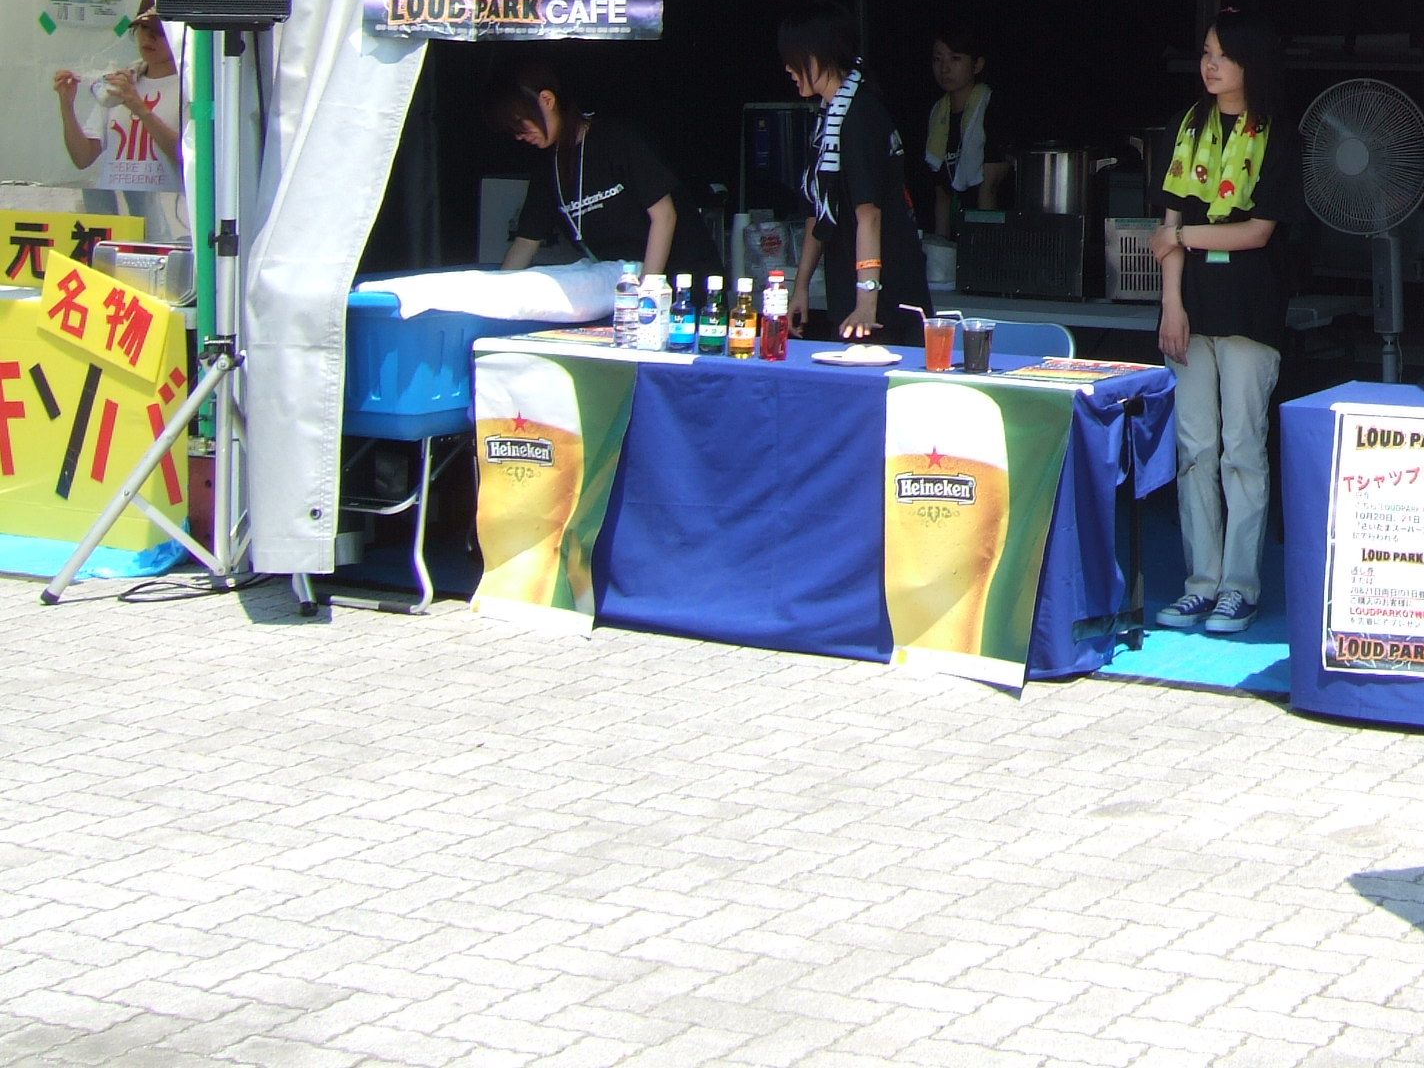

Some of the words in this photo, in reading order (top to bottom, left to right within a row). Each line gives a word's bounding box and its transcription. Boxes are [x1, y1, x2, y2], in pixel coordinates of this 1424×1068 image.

[48, 268, 154, 367] 名物
[1355, 425, 1405, 450] LOUD
[489, 440, 551, 461] Heineken
[900, 478, 972, 499] Heineken
[1361, 547, 1391, 563] LOUD
[1393, 551, 1424, 565] PARK
[1336, 634, 1386, 661] LOUD
